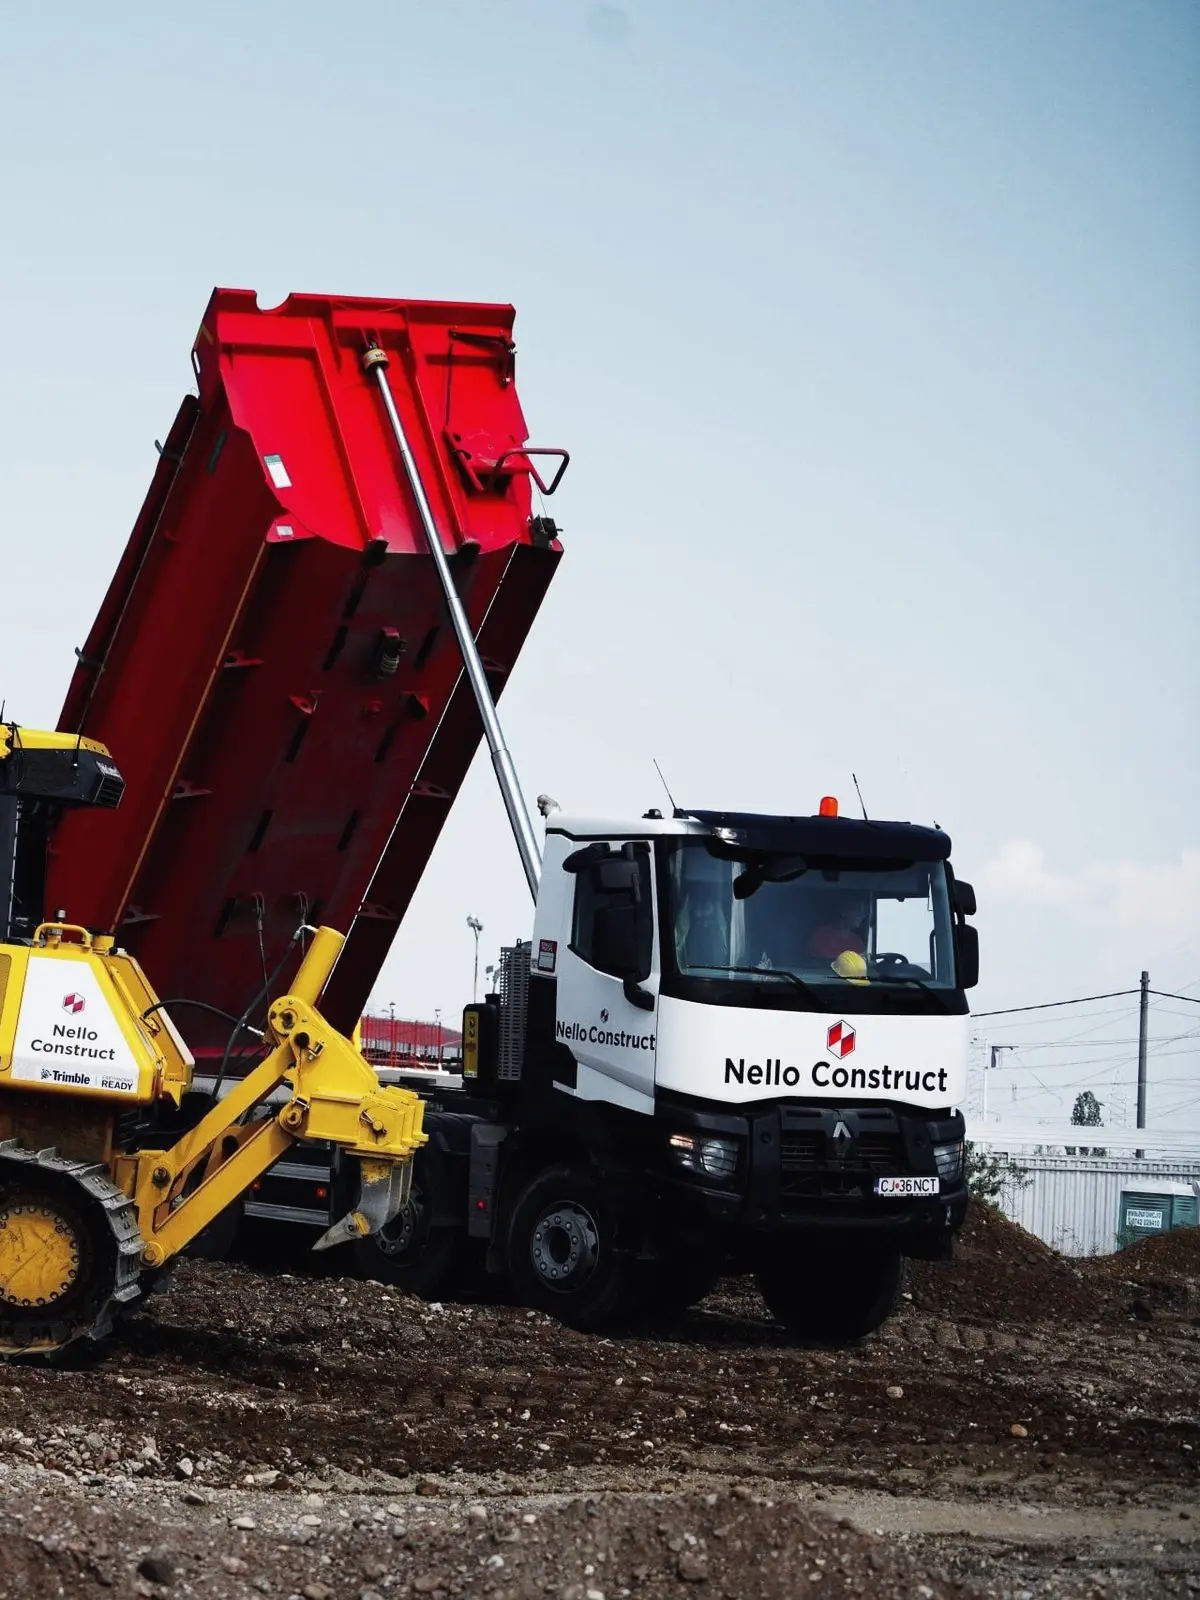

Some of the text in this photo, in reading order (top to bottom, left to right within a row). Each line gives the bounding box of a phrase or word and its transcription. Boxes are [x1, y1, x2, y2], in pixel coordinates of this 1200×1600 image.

[52, 1024, 99, 1041] Nello
[556, 1020, 656, 1051] Nello Construct
[30, 1039, 116, 1061] Construct
[52, 1070, 91, 1085] Trimble
[724, 1057, 948, 1092] Nello Construct
[101, 1080, 133, 1091] READY
